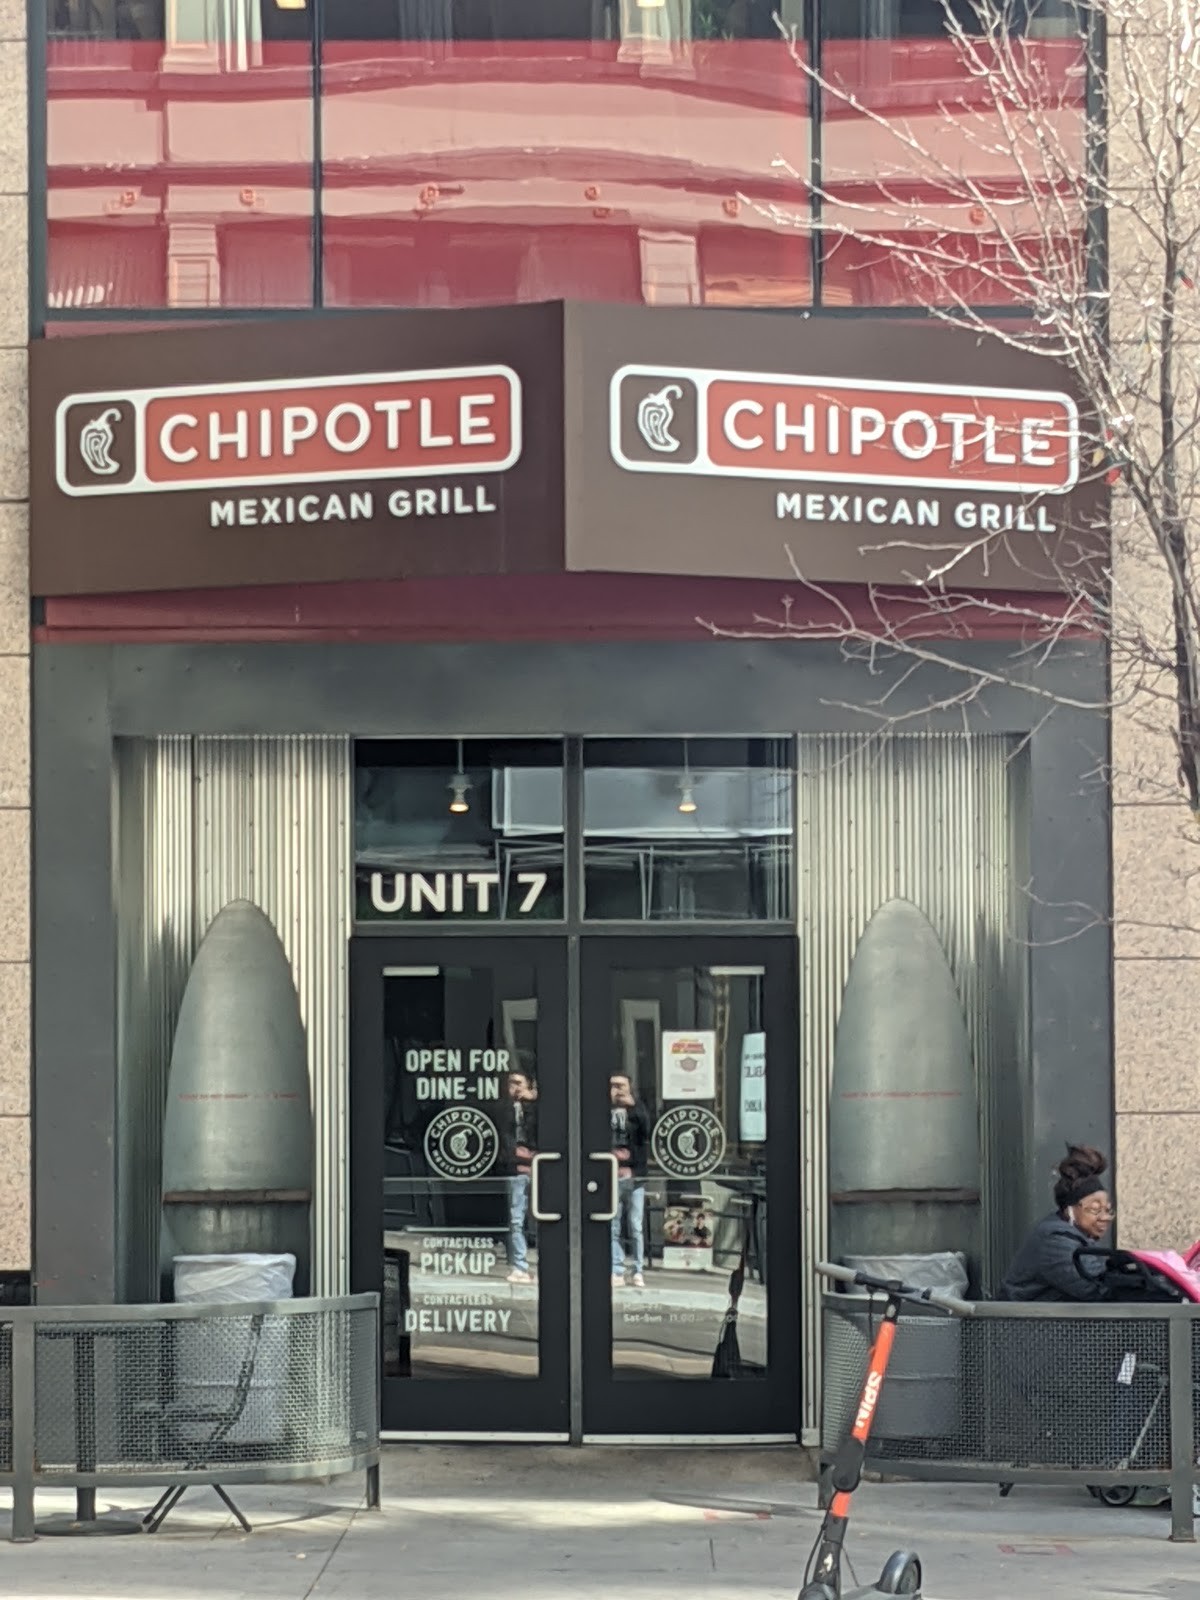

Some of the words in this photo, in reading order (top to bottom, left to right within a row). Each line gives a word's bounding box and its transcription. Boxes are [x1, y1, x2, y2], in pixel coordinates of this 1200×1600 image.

[159, 393, 496, 464] CHIPOTLE
[723, 400, 1056, 467] CHIPOTLE
[210, 492, 374, 527] MEXICAN
[388, 486, 496, 518] GRILL
[776, 492, 940, 527] MEXICAN
[954, 501, 1056, 533] GRILL
[371, 872, 500, 913] UNIT
[516, 872, 547, 913] 7
[405, 1049, 462, 1072] OPEN
[469, 1049, 510, 1072] FOR
[416, 1077, 499, 1100] DINE-IN
[431, 1111, 493, 1139] CHIPOTLE
[658, 1110, 720, 1138] CHIPOTLE
[422, 1237, 494, 1249] CONTACTLESS
[420, 1252, 496, 1275] PICKUP
[422, 1294, 494, 1306] CONTACTLESS
[404, 1309, 511, 1333] DELIVERY
